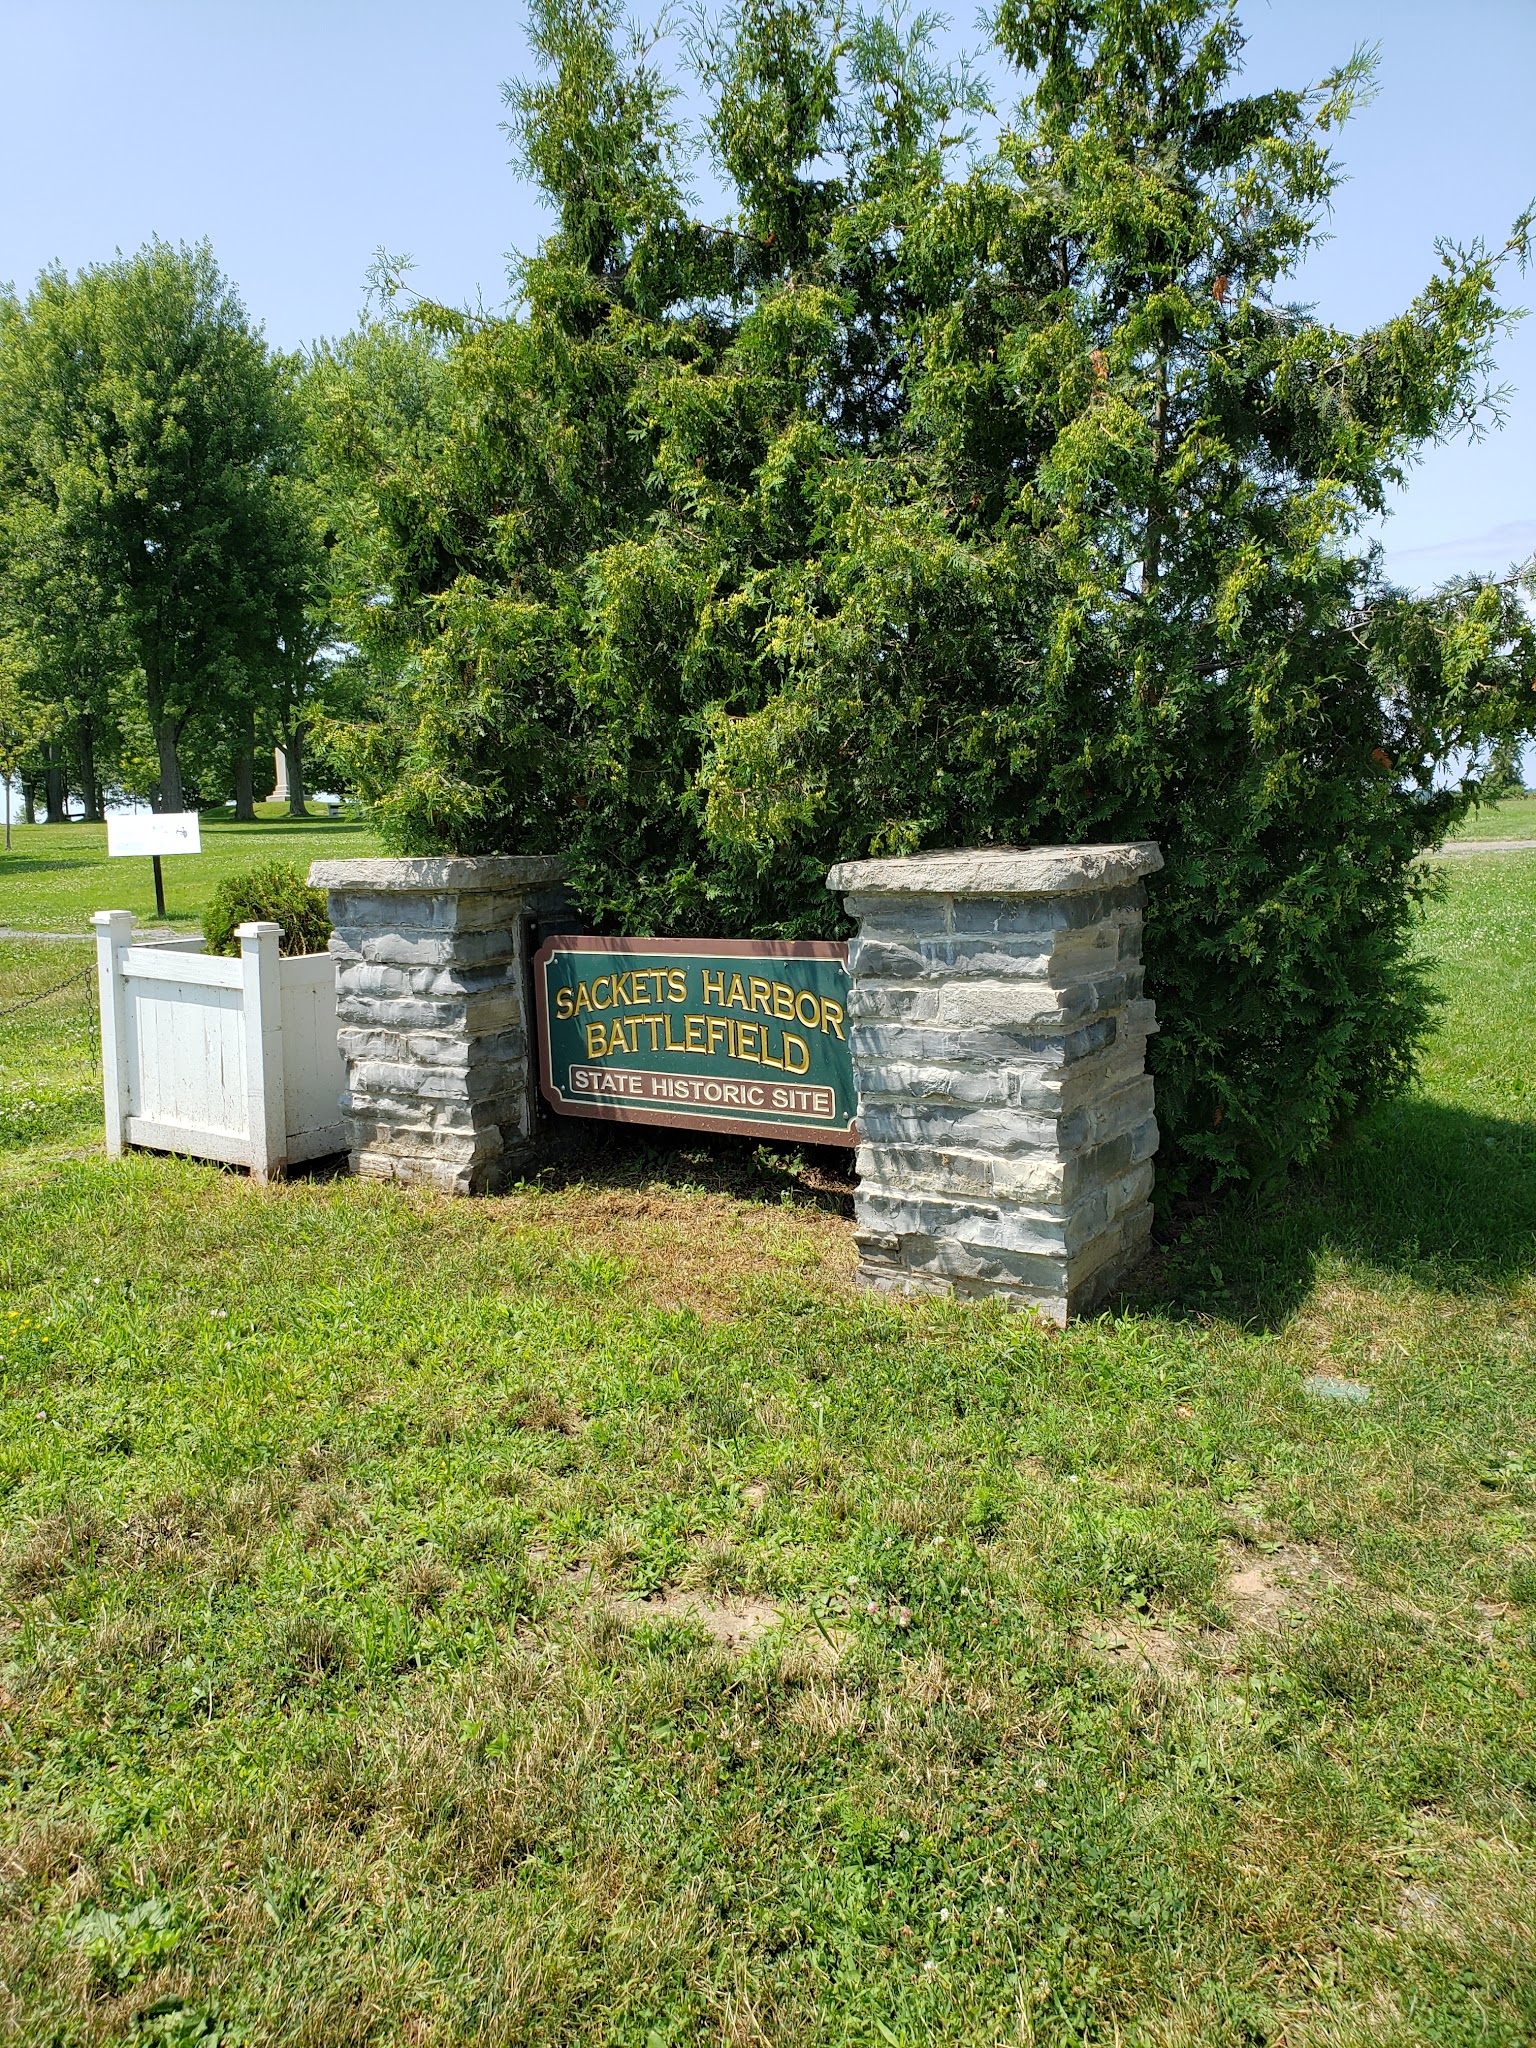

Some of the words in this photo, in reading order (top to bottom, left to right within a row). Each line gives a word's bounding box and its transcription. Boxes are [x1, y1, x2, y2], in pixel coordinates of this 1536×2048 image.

[555, 966, 688, 1020] SACKETS
[701, 969, 847, 1041] HARBOR
[585, 1012, 810, 1075] BATTLEFIELD
[575, 1070, 643, 1094] STATE
[652, 1077, 764, 1106] HISTORIC
[772, 1088, 830, 1113] SITE
